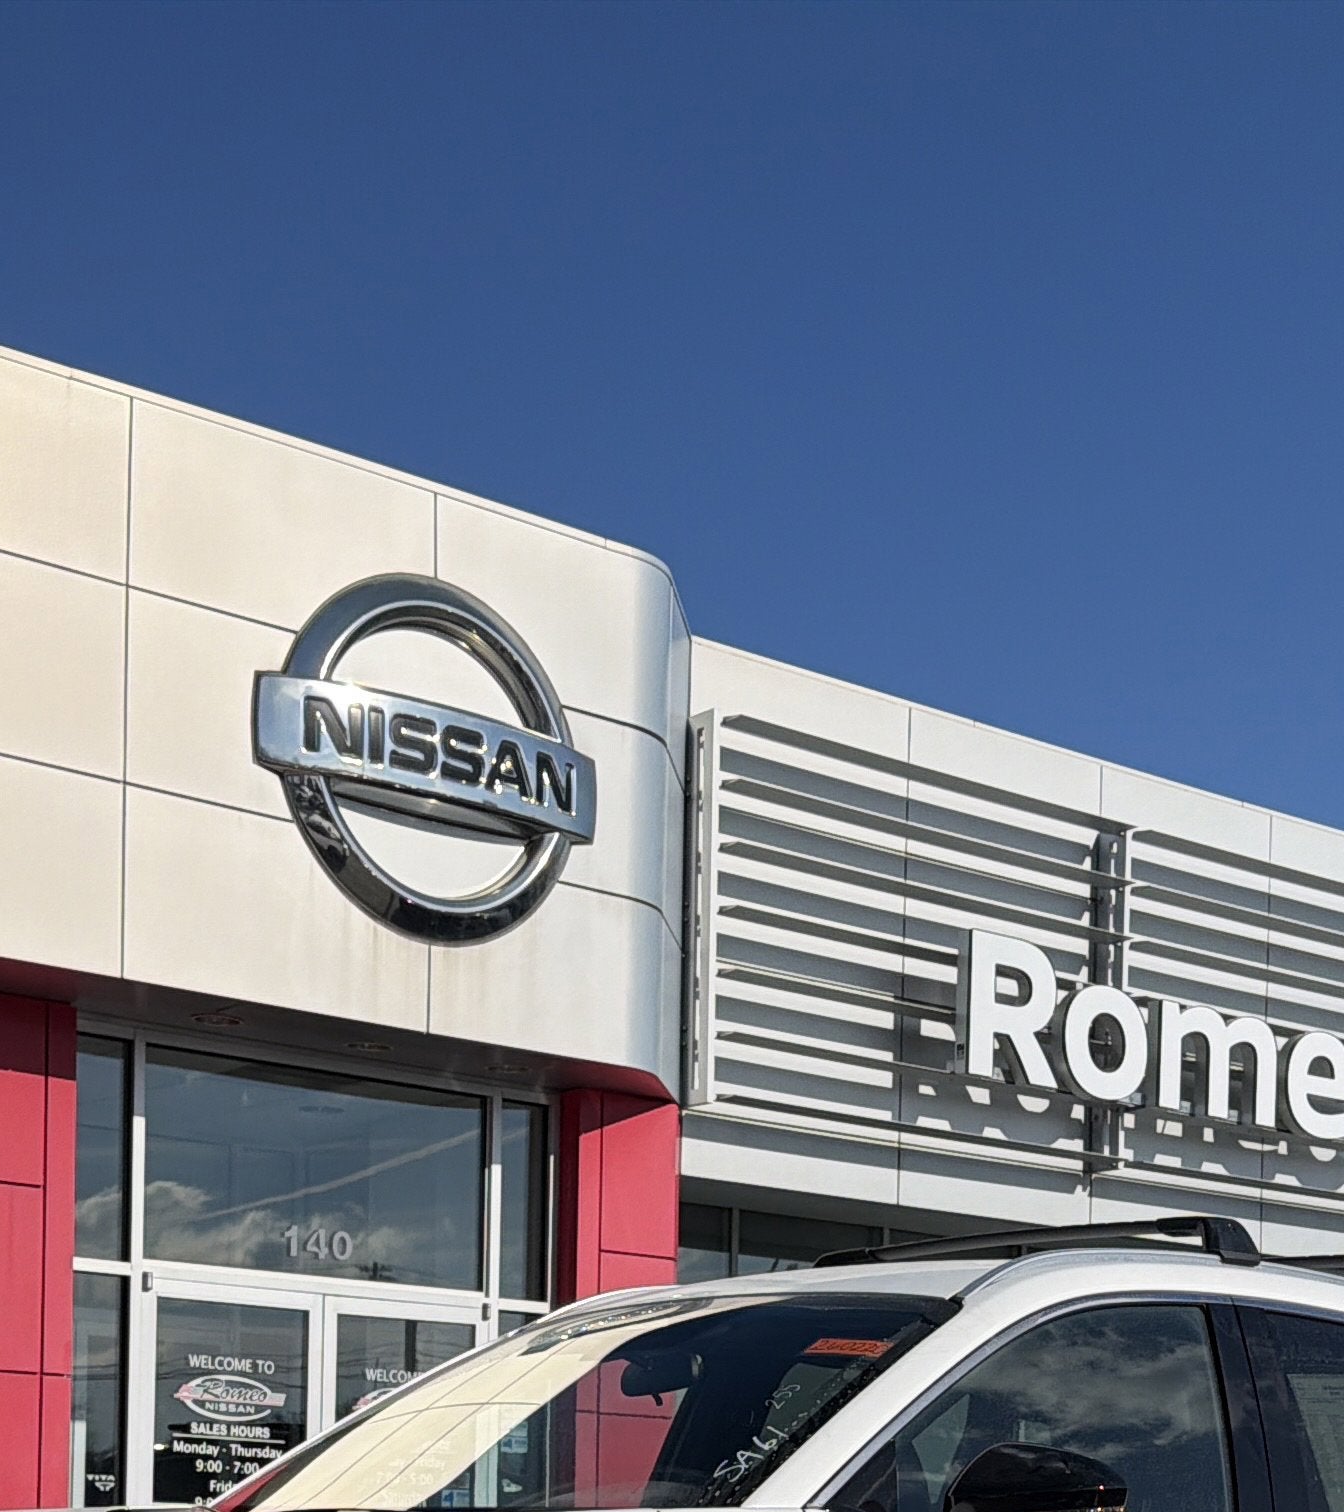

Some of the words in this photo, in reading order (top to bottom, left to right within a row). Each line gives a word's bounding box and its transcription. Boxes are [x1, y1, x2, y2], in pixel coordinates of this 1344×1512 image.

[302, 694, 577, 817] NISSAN
[283, 1224, 354, 1260] 140
[188, 1353, 253, 1373] WELCOME
[256, 1360, 275, 1375] TO
[196, 1378, 268, 1403] Romeo
[205, 1402, 256, 1414] NISSAN
[190, 1421, 228, 1437] SALES
[230, 1425, 271, 1439] HOURS
[172, 1440, 220, 1458] Monday
[229, 1443, 283, 1459] Thursday
[195, 1459, 223, 1474] 9:00
[233, 1461, 260, 1474] 7:00
[209, 1479, 237, 1493] Frid
